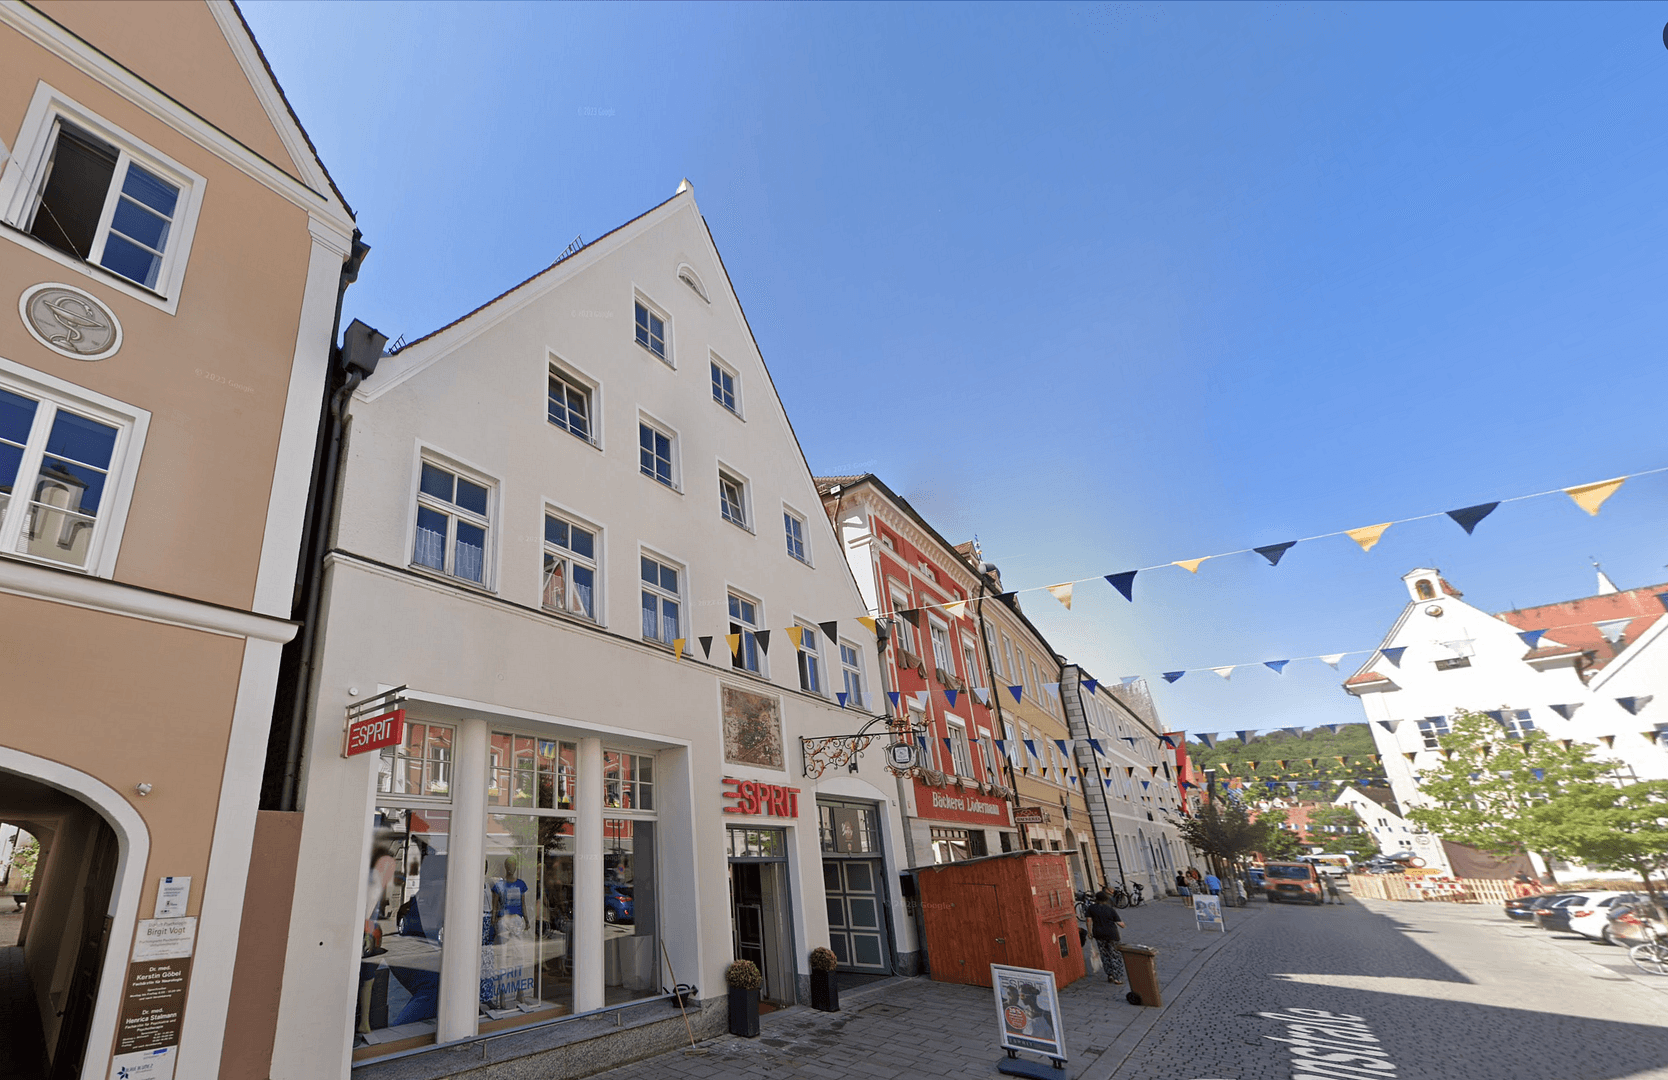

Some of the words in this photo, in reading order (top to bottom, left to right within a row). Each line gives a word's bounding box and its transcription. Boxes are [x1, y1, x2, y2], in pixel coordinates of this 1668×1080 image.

[351, 717, 394, 748] ESPRIT
[722, 778, 801, 818] ESPRIT
[932, 791, 964, 811] Bäckerei
[147, 928, 167, 937] Birgit
[169, 927, 186, 936] Vogt
[162, 970, 182, 978] Göbel
[492, 965, 523, 983] SPRIT
[492, 978, 534, 997] UMMER
